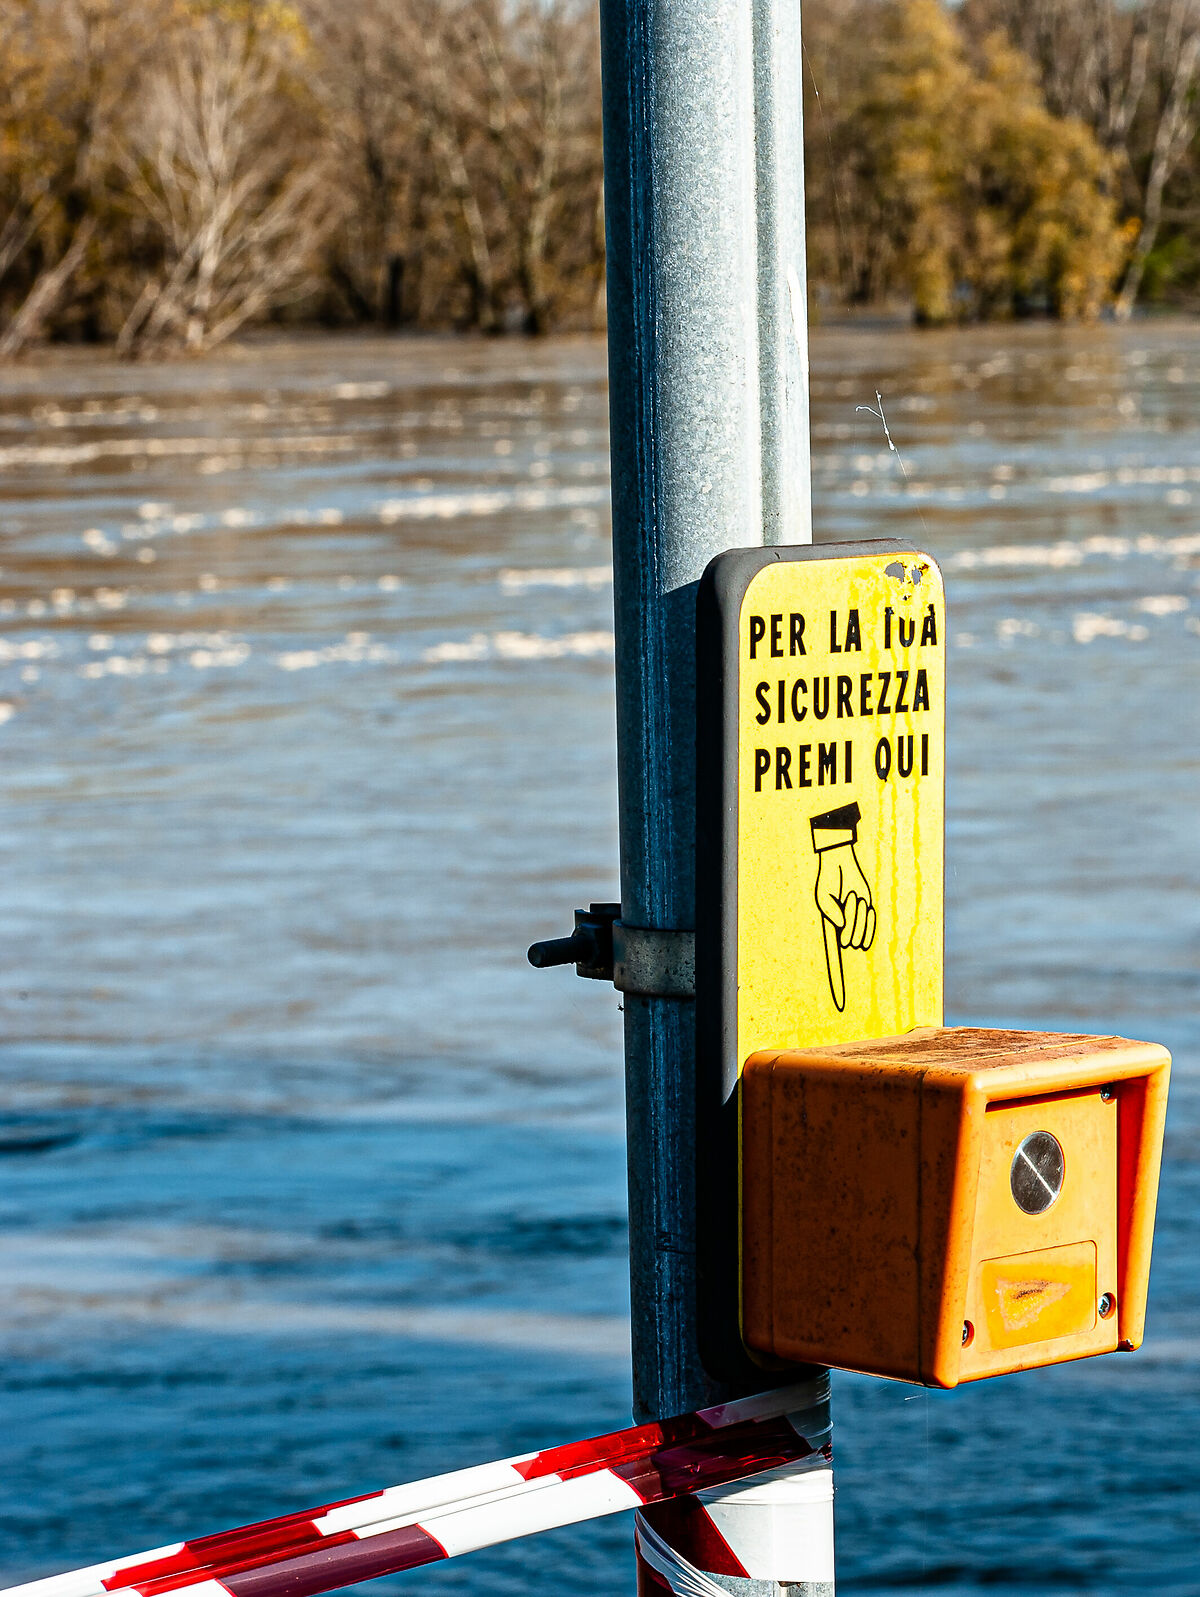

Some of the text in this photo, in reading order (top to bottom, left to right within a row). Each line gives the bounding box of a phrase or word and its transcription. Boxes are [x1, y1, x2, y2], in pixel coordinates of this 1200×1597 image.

[750, 613, 807, 659] PER
[830, 609, 862, 653] LA
[755, 669, 930, 725] SICUREZZA
[755, 733, 929, 792] PREMI QUI
